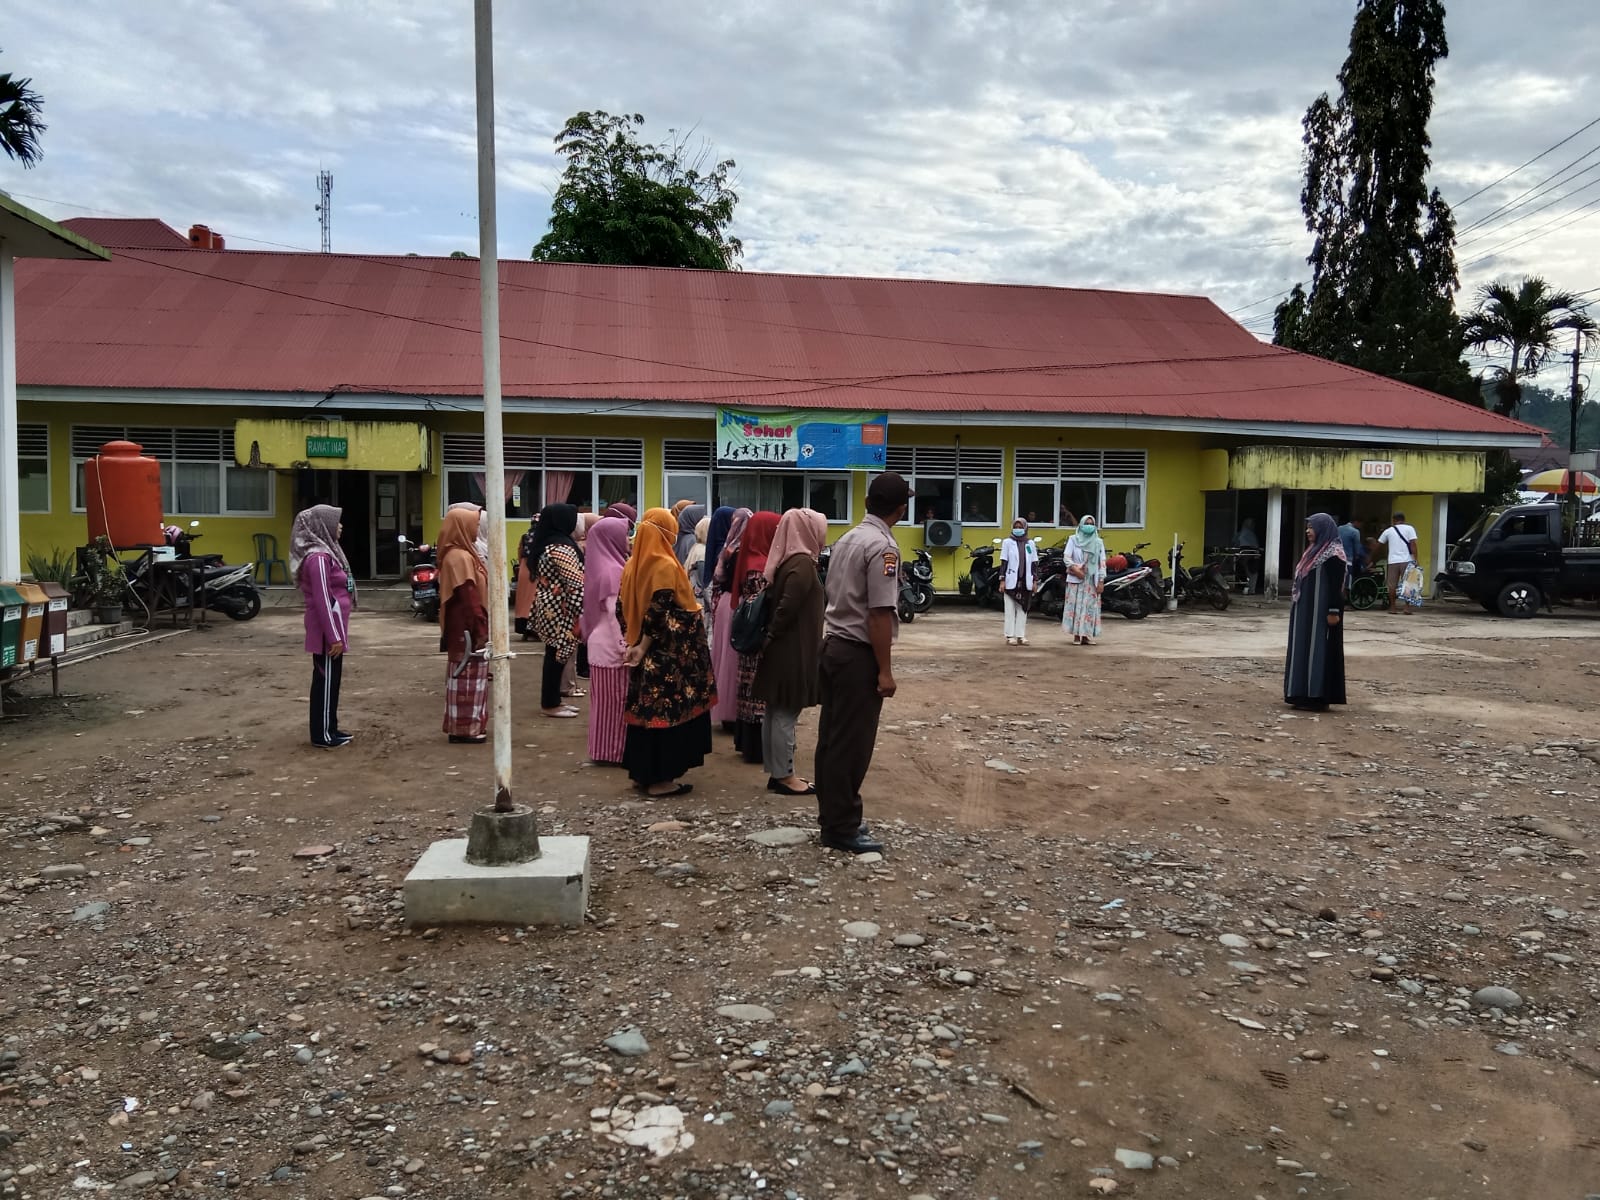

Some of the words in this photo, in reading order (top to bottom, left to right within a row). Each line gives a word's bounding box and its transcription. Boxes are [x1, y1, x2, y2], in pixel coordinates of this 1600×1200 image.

[743, 423, 793, 438] Sehat
[308, 441, 330, 453] RAWAT
[331, 441, 346, 453] INAP
[1365, 464, 1392, 475] UGD
